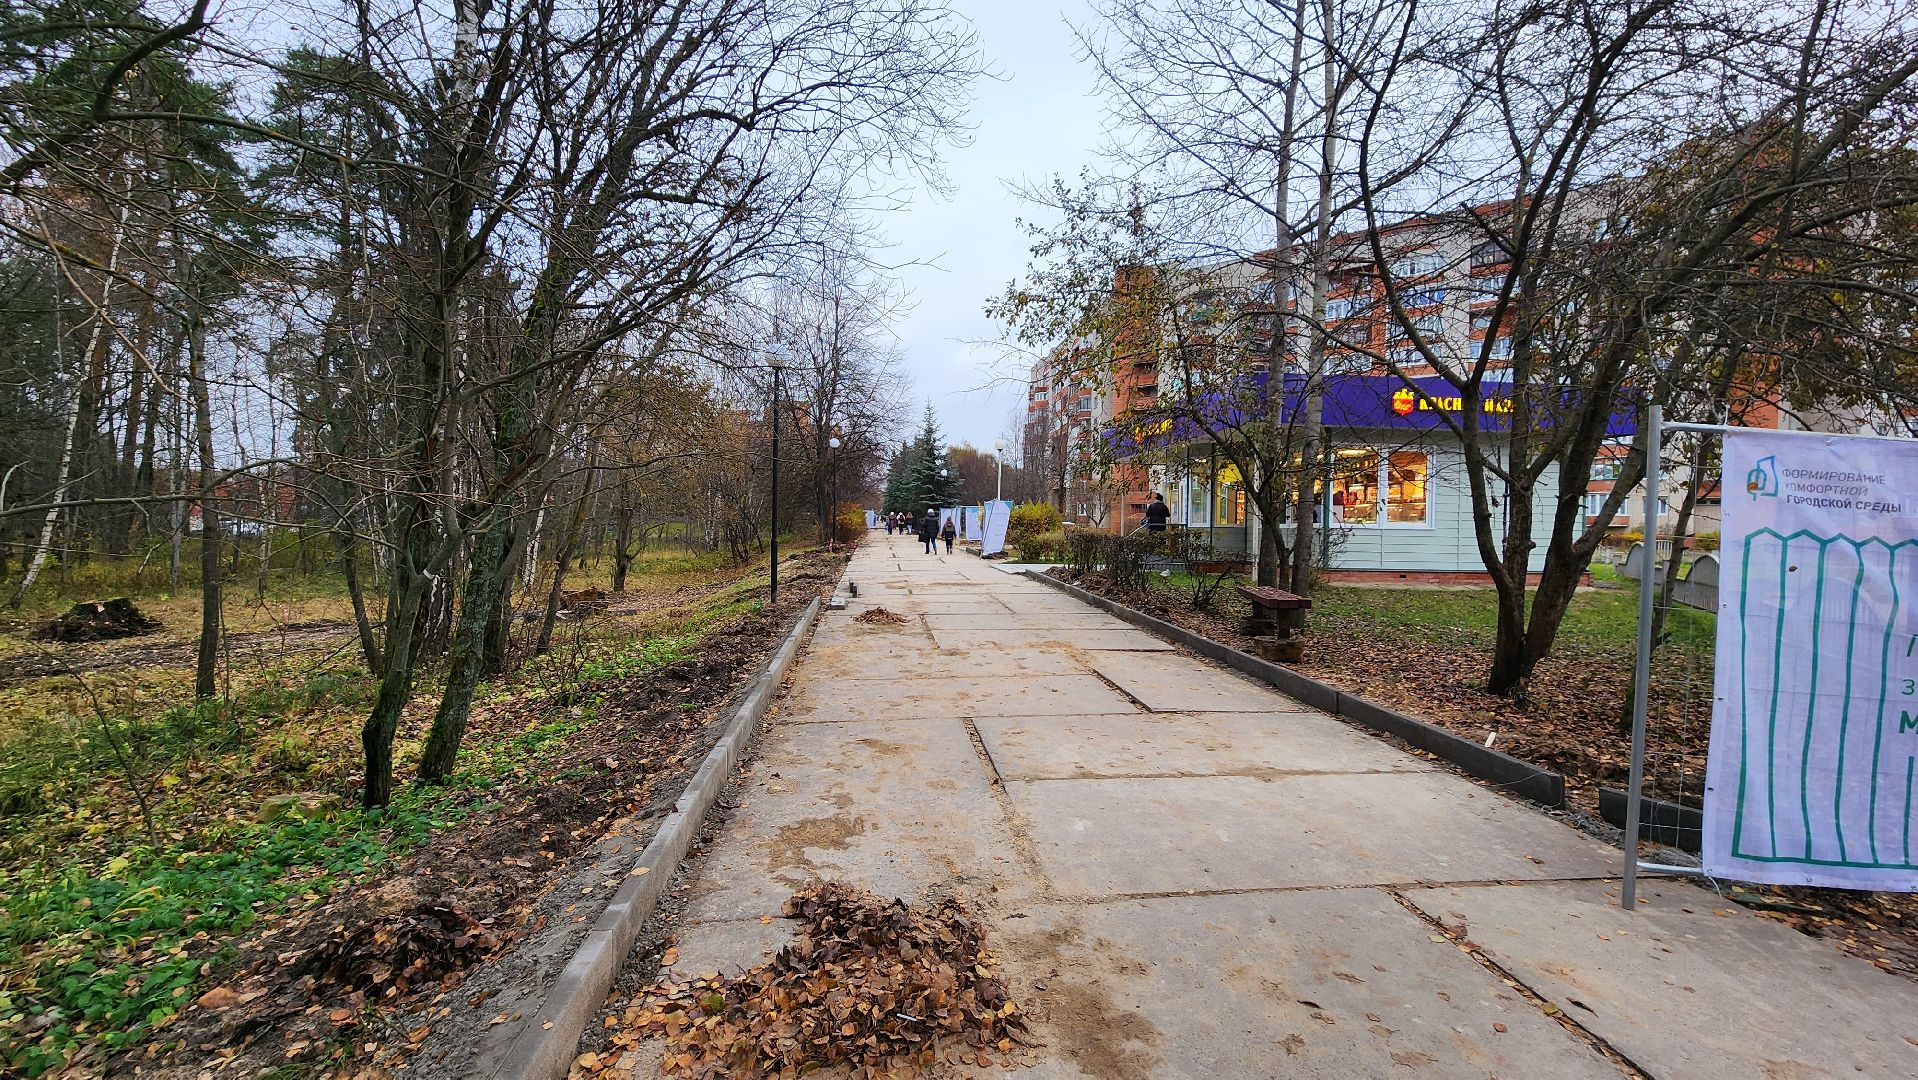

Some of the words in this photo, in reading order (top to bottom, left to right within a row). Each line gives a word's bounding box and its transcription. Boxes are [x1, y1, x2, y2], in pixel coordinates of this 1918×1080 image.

[1782, 468, 1886, 485] ФОРМИРОВАНИЕ
[1786, 494, 1852, 509] ГОРОДСКОЙ
[1855, 501, 1901, 513] СРЕДЫ
